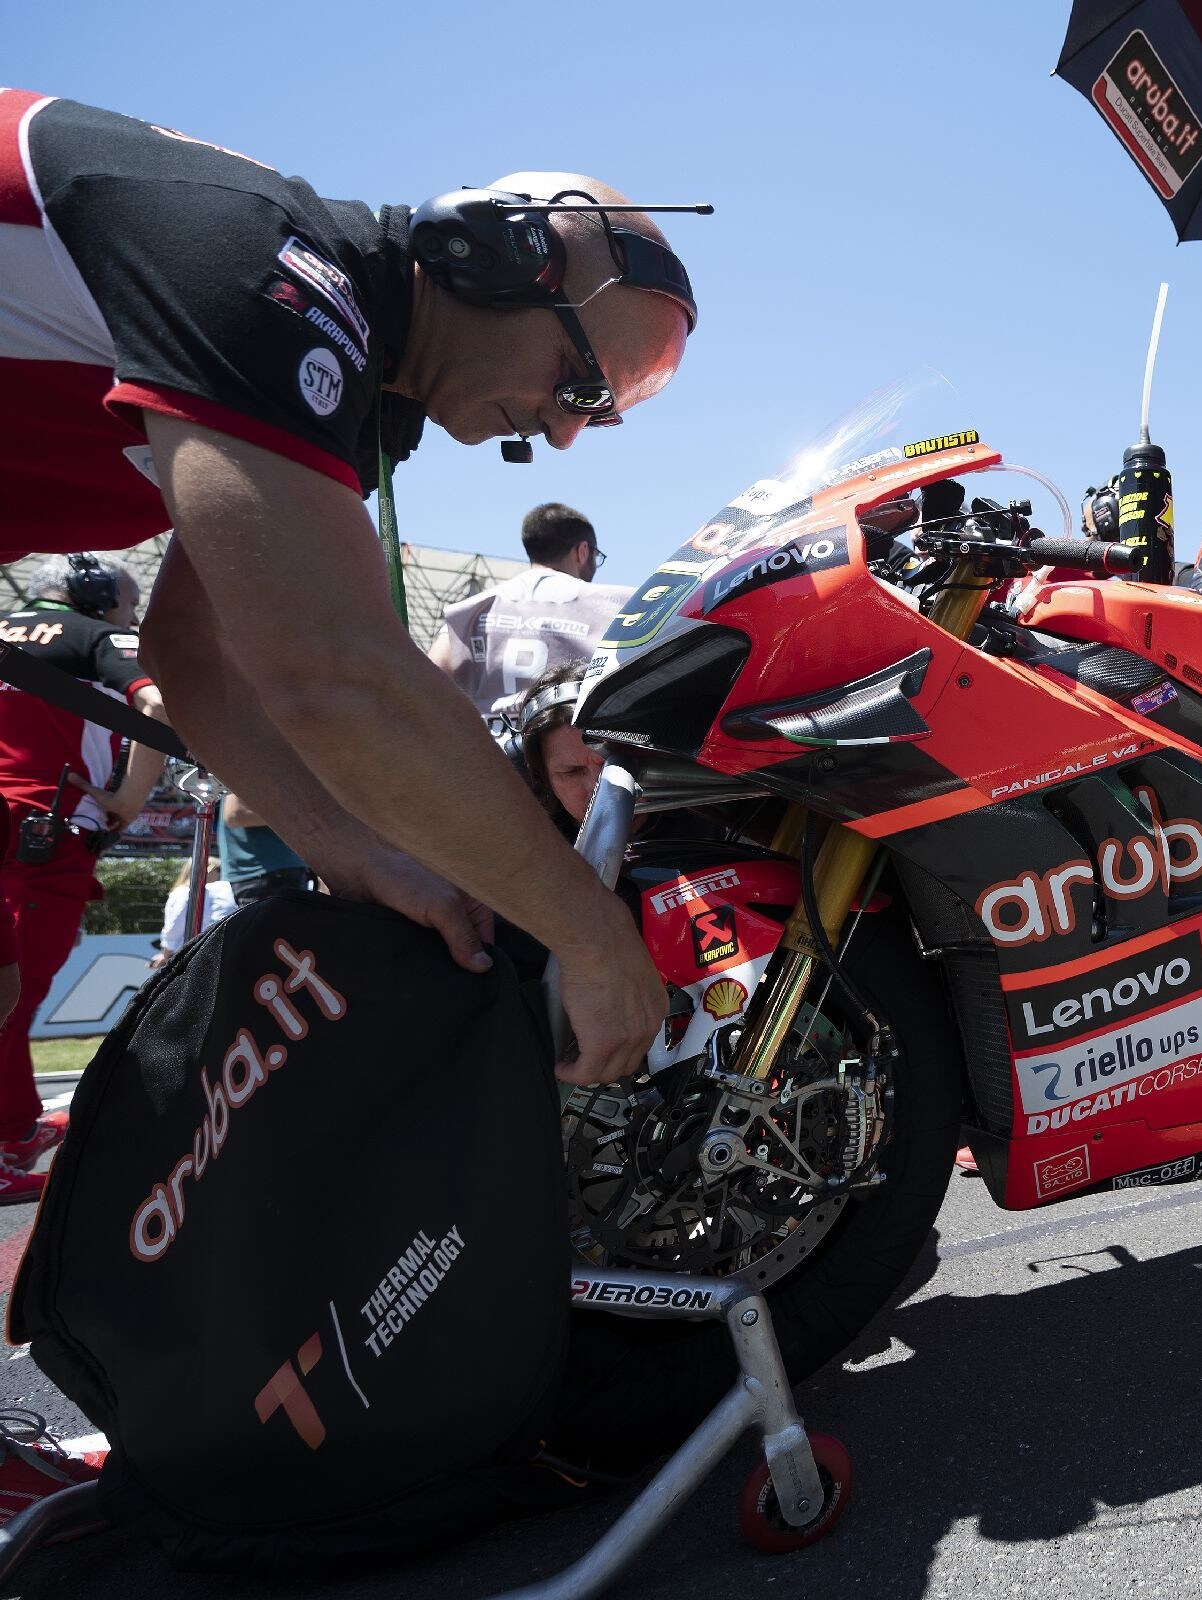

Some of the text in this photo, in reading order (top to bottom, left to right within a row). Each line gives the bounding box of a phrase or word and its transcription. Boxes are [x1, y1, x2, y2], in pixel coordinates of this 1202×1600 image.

[1114, 96, 1168, 173] Ducati Superbike Team
[1126, 59, 1199, 156] aruba.it
[305, 306, 368, 372] AKRAPOVIC
[304, 361, 342, 403] STM
[904, 430, 978, 459] BAUTISTA
[713, 540, 835, 600] Lenovo
[502, 637, 549, 694] P
[991, 753, 1108, 799] PANIGALE
[1111, 743, 1139, 759] V4
[650, 869, 741, 914] PIRELLI
[1022, 957, 1191, 1036] Lenovo
[1074, 1025, 1200, 1088] riello ups
[130, 938, 347, 1262] aruba.it
[1116, 1162, 1192, 1191] Muc-Off
[360, 1229, 437, 1326] THERMAL
[364, 1224, 466, 1358] TECHNOLOGY
[570, 1279, 713, 1310] PIEROBON
